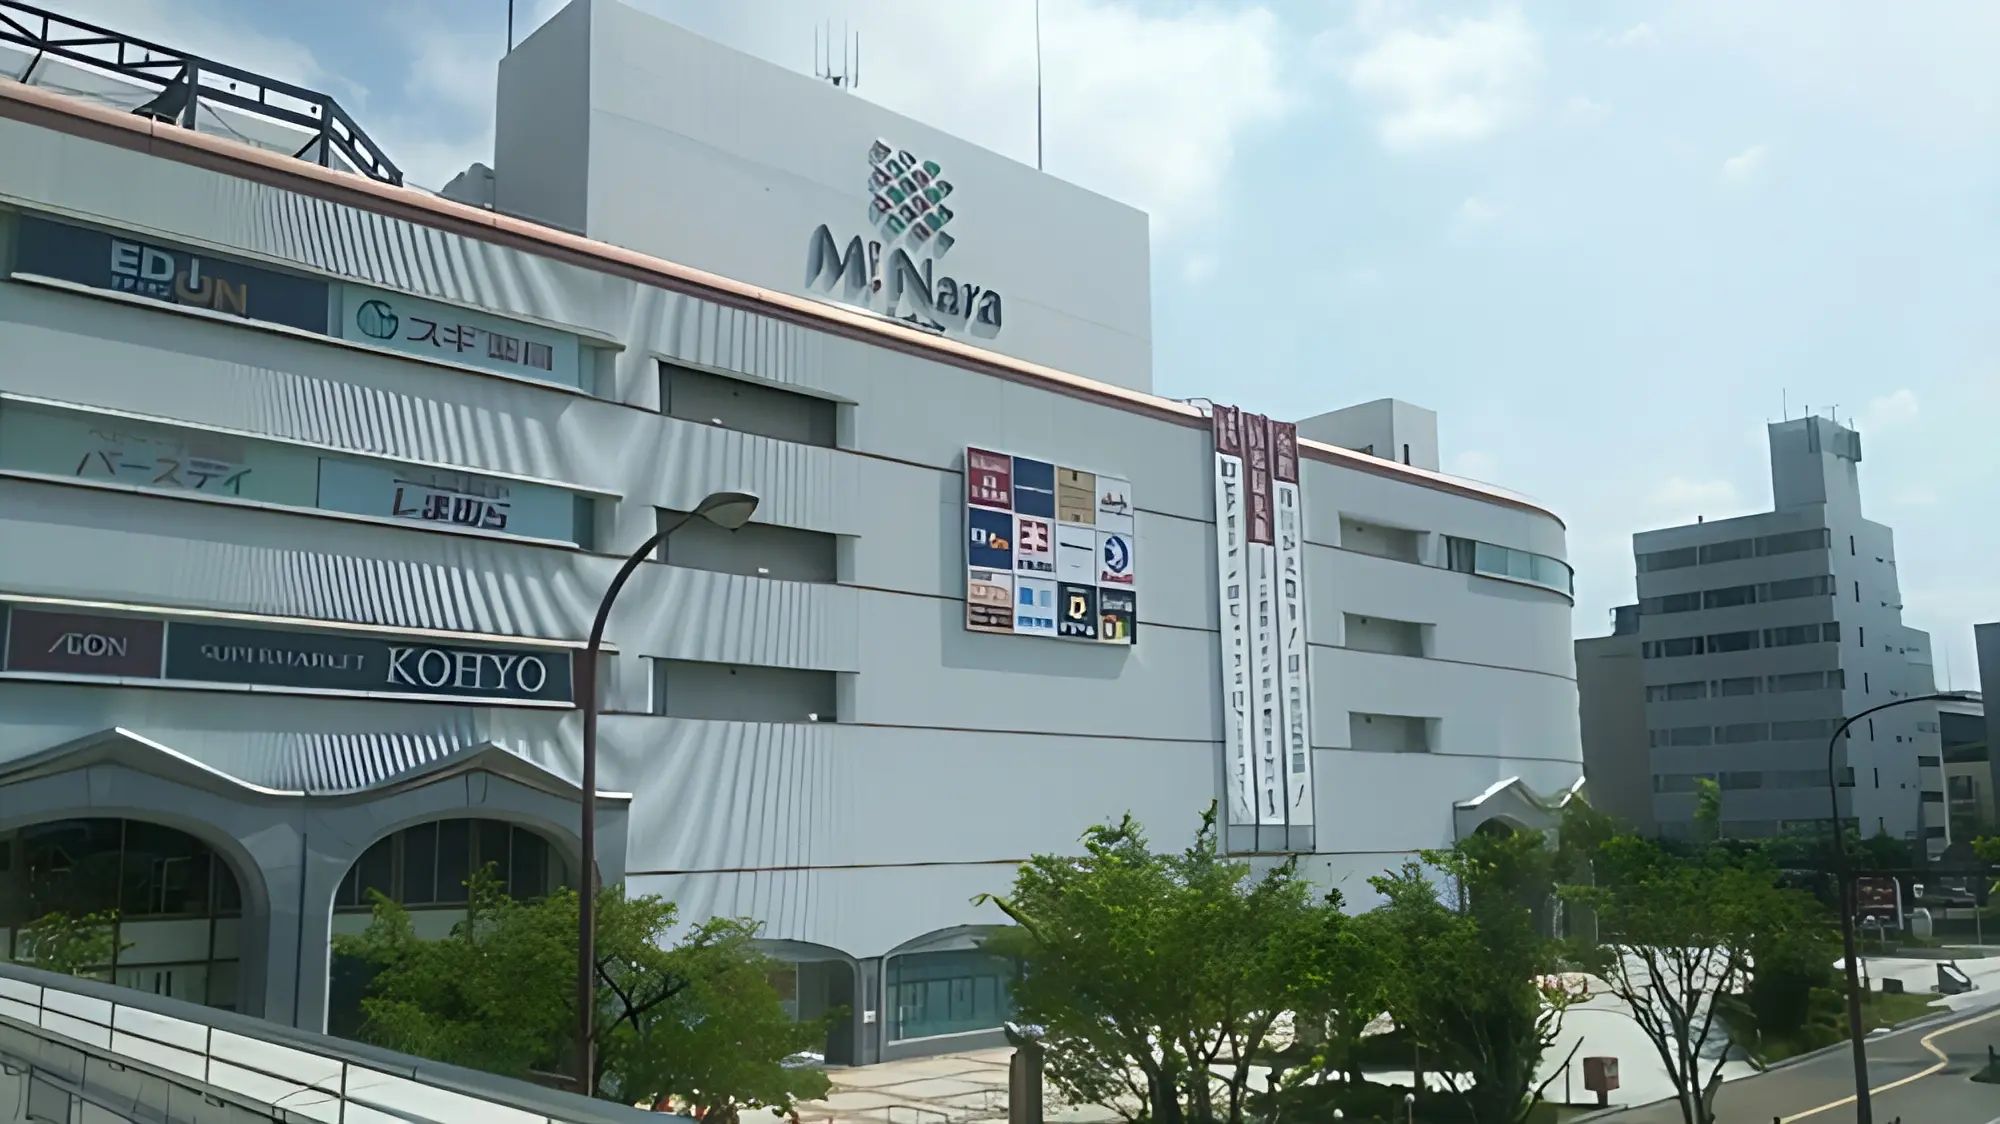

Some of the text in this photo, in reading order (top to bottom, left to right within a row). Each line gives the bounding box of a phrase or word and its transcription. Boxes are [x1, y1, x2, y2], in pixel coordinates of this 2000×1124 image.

[110, 238, 248, 316] EDION
[886, 247, 1002, 338] Nara
[406, 315, 554, 371] スギ
[386, 646, 547, 693] KOHYO
